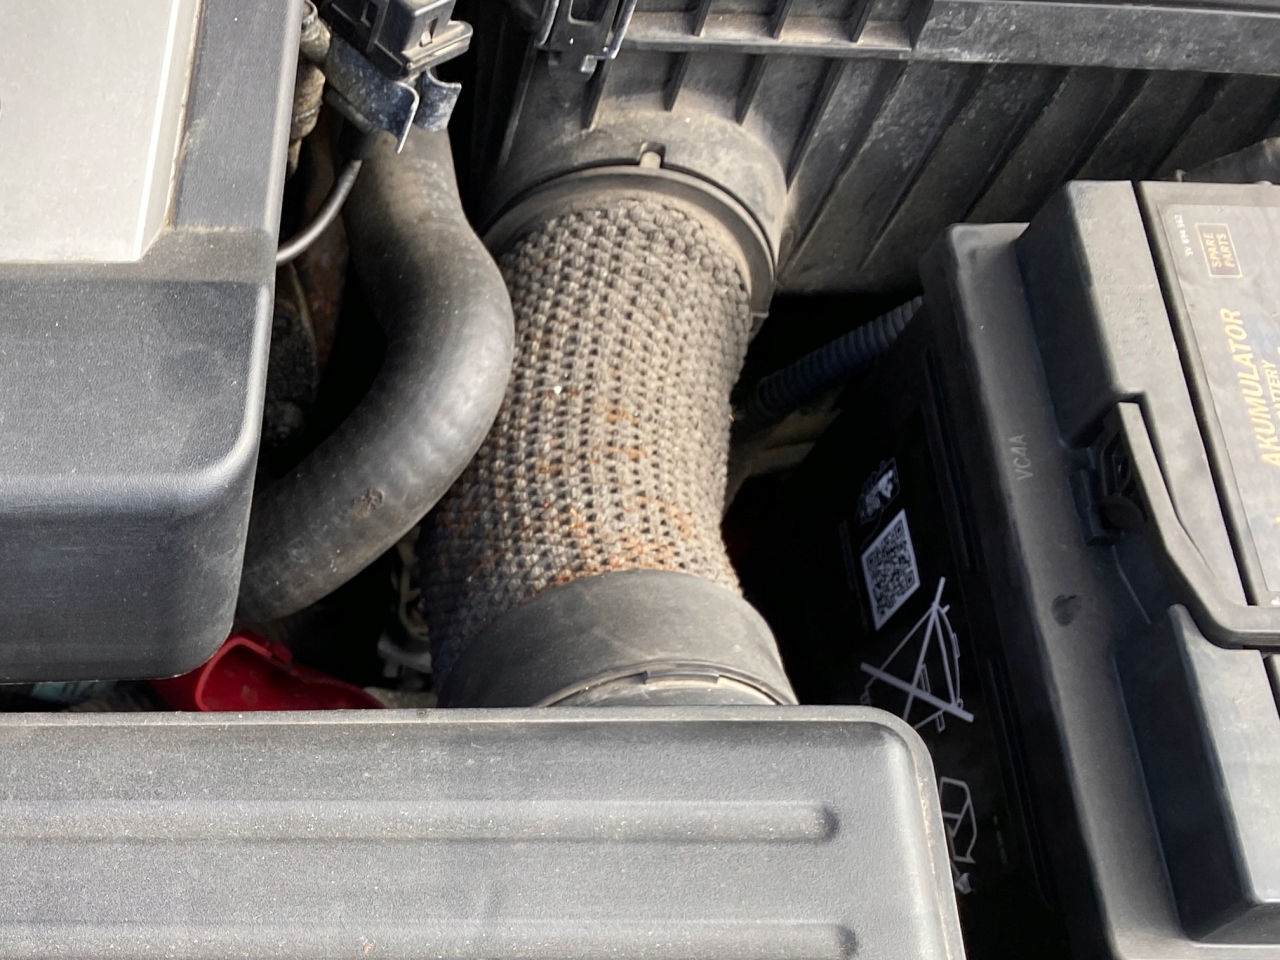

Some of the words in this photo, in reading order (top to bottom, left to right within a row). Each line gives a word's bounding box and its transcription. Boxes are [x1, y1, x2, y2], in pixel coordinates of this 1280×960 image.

[1203, 231, 1222, 268] SPARE
[1216, 232, 1236, 268] PARTS
[1220, 307, 1280, 467] AKUMULATOR
[1008, 434, 1034, 480] VC4A
